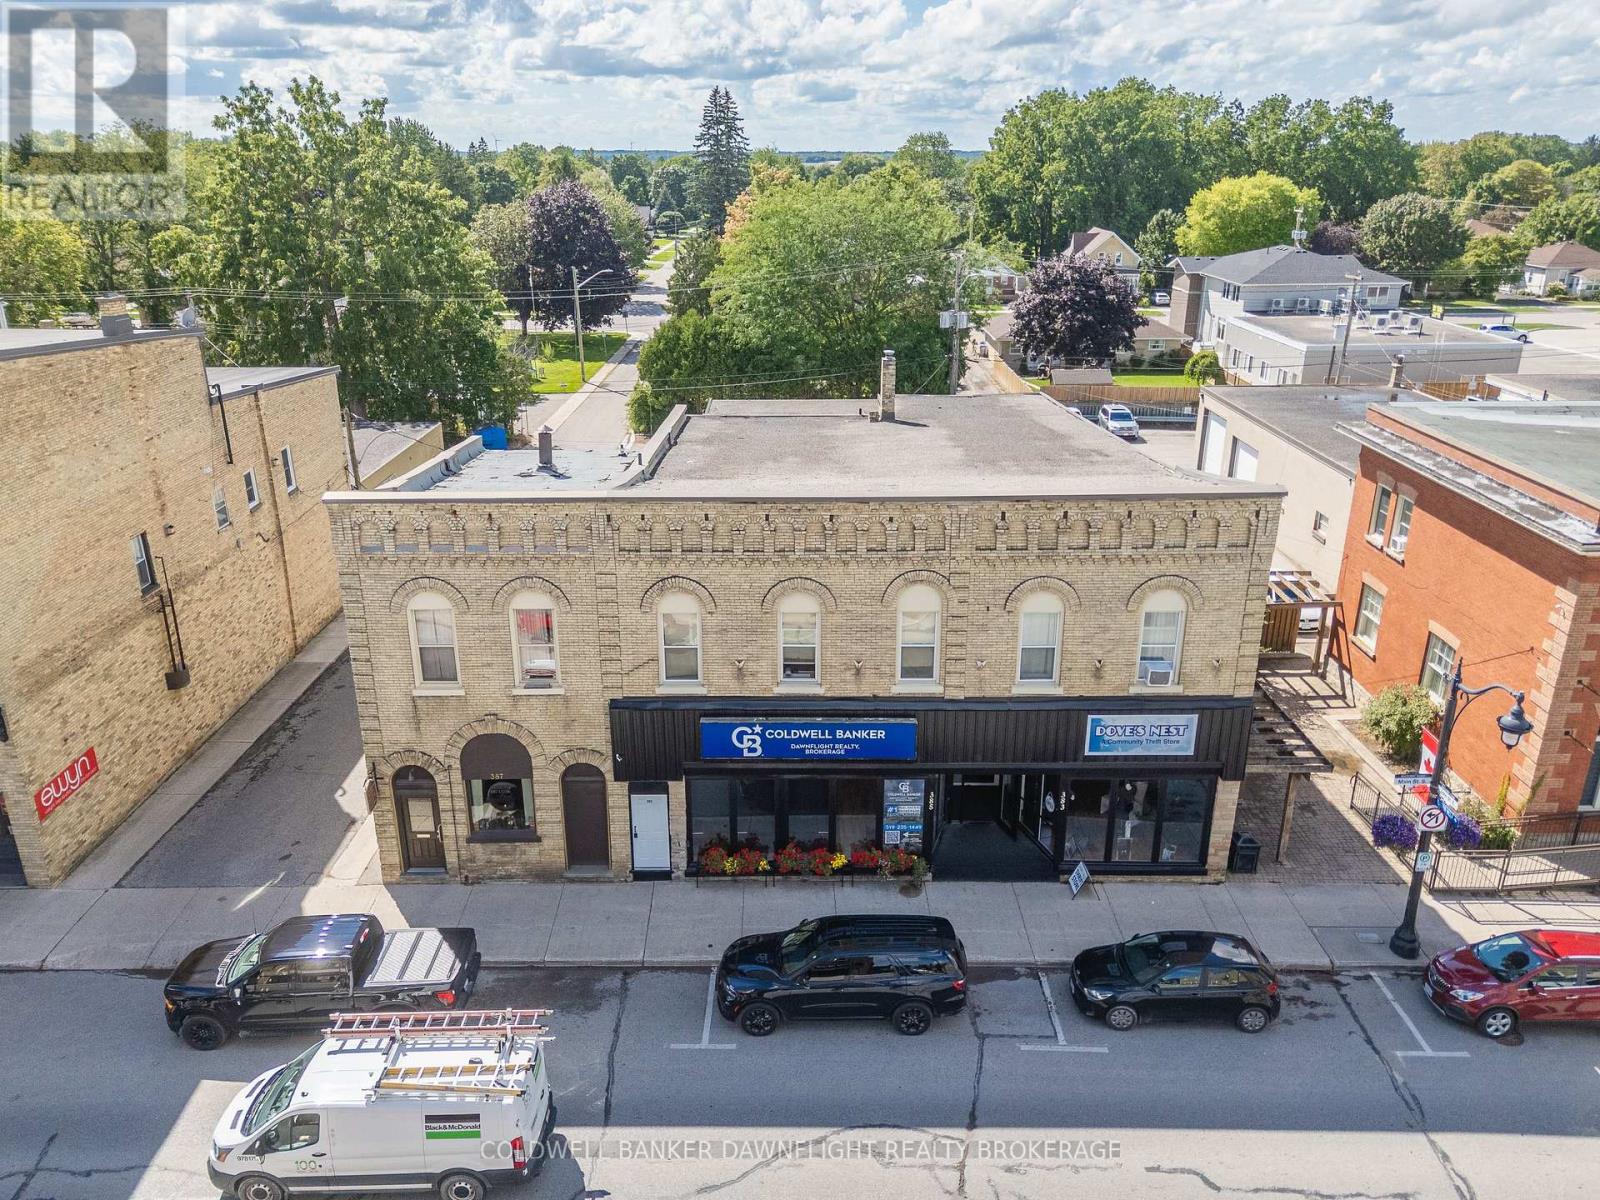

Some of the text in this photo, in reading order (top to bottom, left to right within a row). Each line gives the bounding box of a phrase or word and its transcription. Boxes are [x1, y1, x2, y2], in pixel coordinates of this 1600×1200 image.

[765, 730, 886, 739] COLDWELL BANKER
[1095, 725, 1188, 737] DOVE'S NEST
[1107, 738, 1143, 746] Community
[40, 755, 91, 807] ewyn
